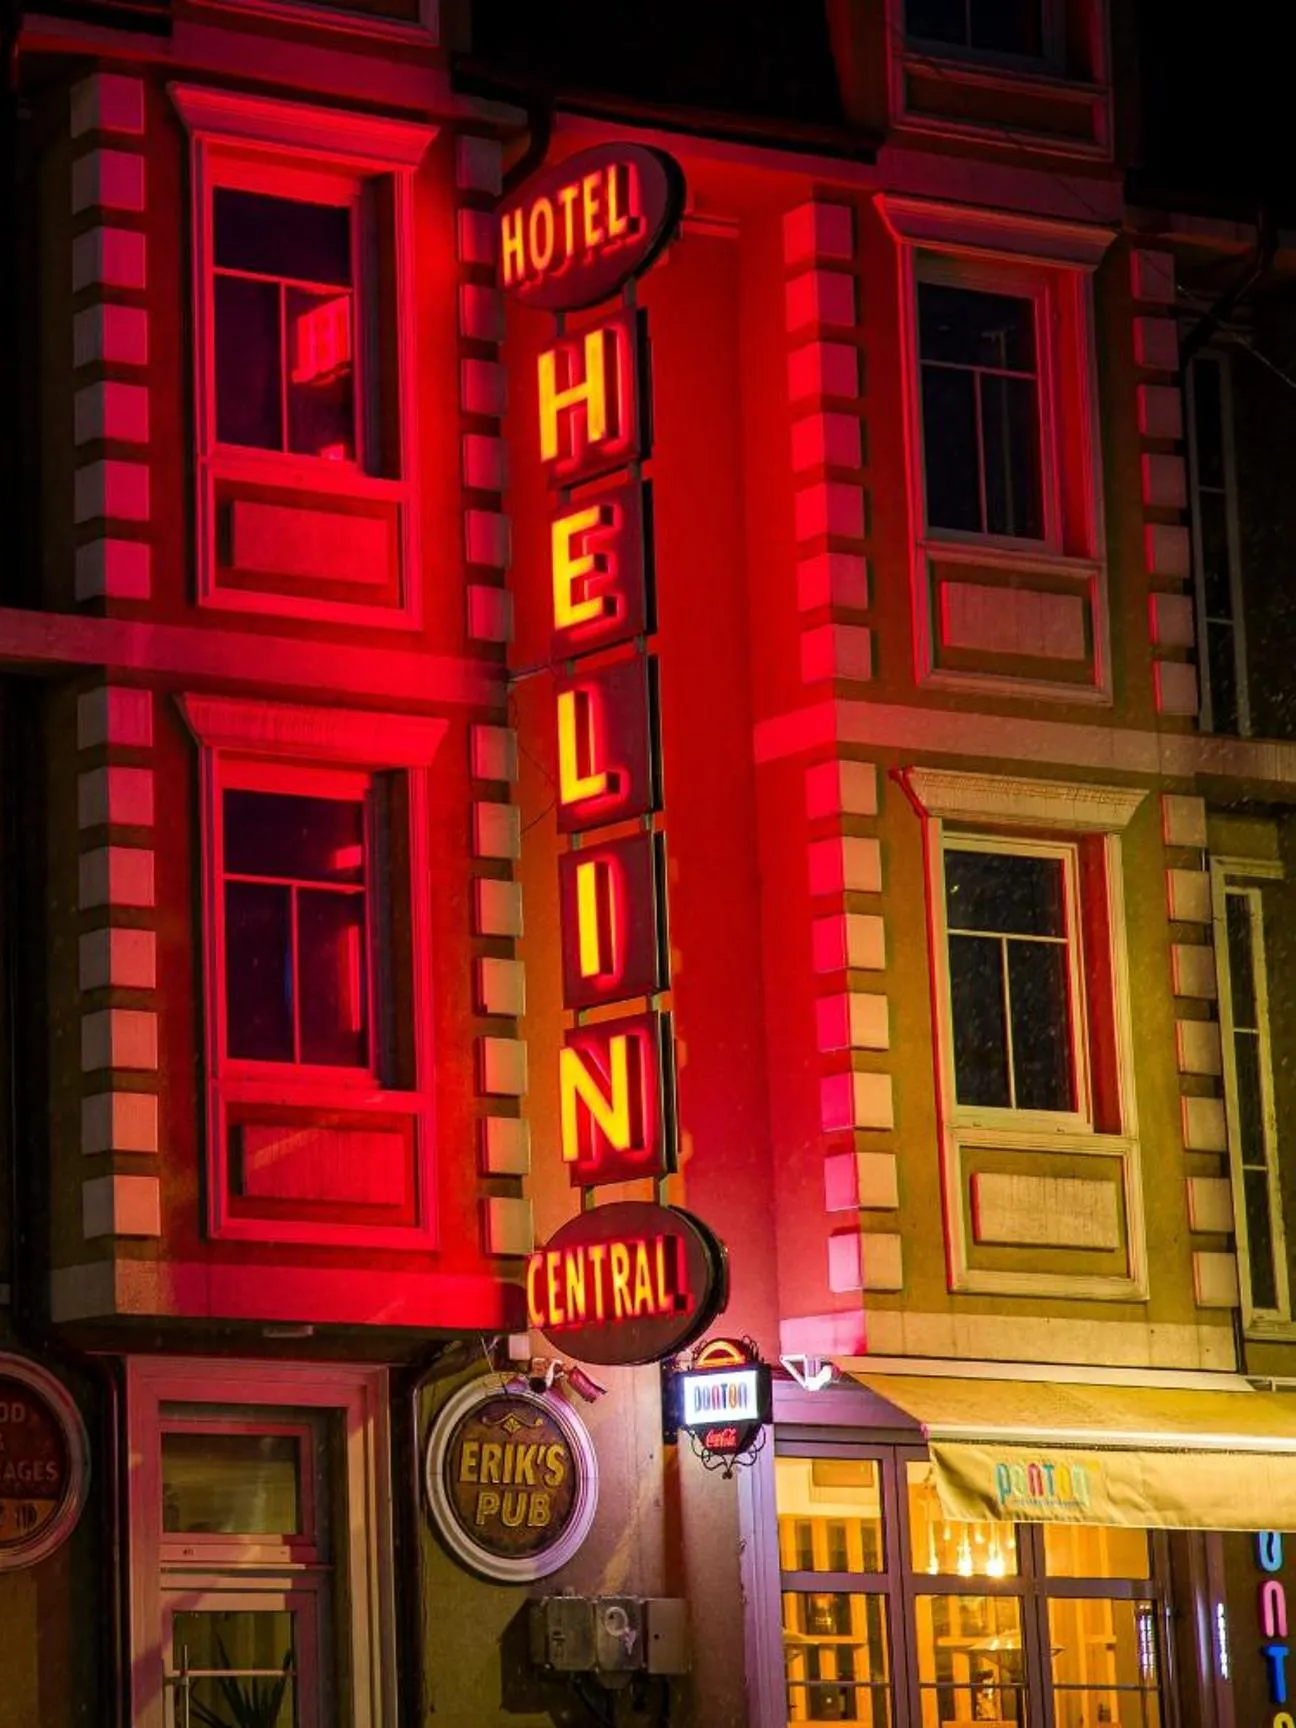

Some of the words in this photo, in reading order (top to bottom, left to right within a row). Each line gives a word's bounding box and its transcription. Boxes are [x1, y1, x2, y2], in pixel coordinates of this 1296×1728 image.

[501, 164, 627, 286] HOTEL
[538, 329, 629, 1162] HELIN
[527, 1237, 675, 1328] CENTRAL
[459, 1441, 565, 1486] ERIK'S
[476, 1492, 551, 1527] PUB
